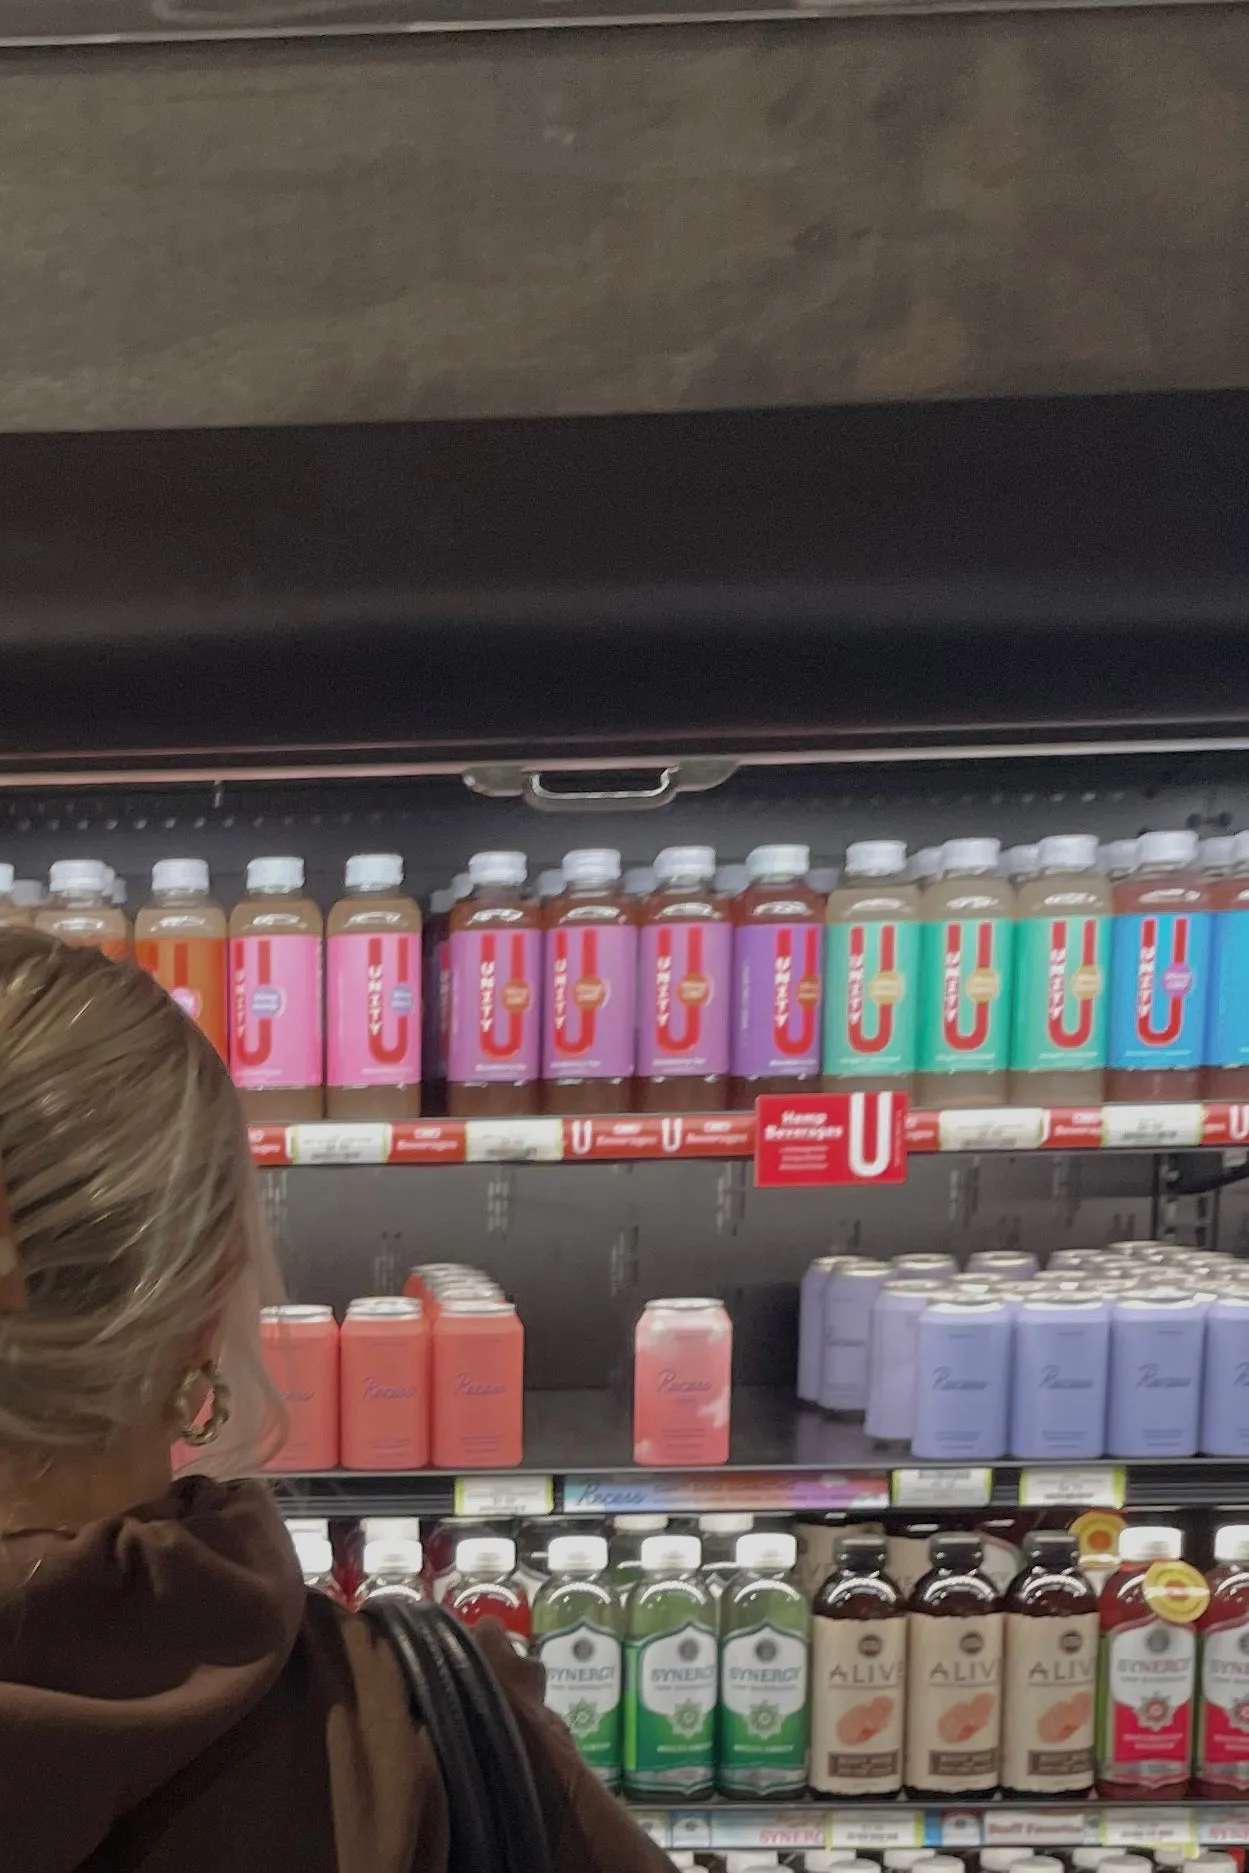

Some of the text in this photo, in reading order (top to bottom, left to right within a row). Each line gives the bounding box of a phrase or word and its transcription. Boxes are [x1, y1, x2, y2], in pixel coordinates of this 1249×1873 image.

[781, 1110, 828, 1126] Hemp
[765, 1125, 844, 1141] Beverages
[848, 1091, 893, 1177] U
[656, 1369, 711, 1393] Recess
[576, 1485, 648, 1506] Recess
[728, 1666, 802, 1681] SYNERGY
